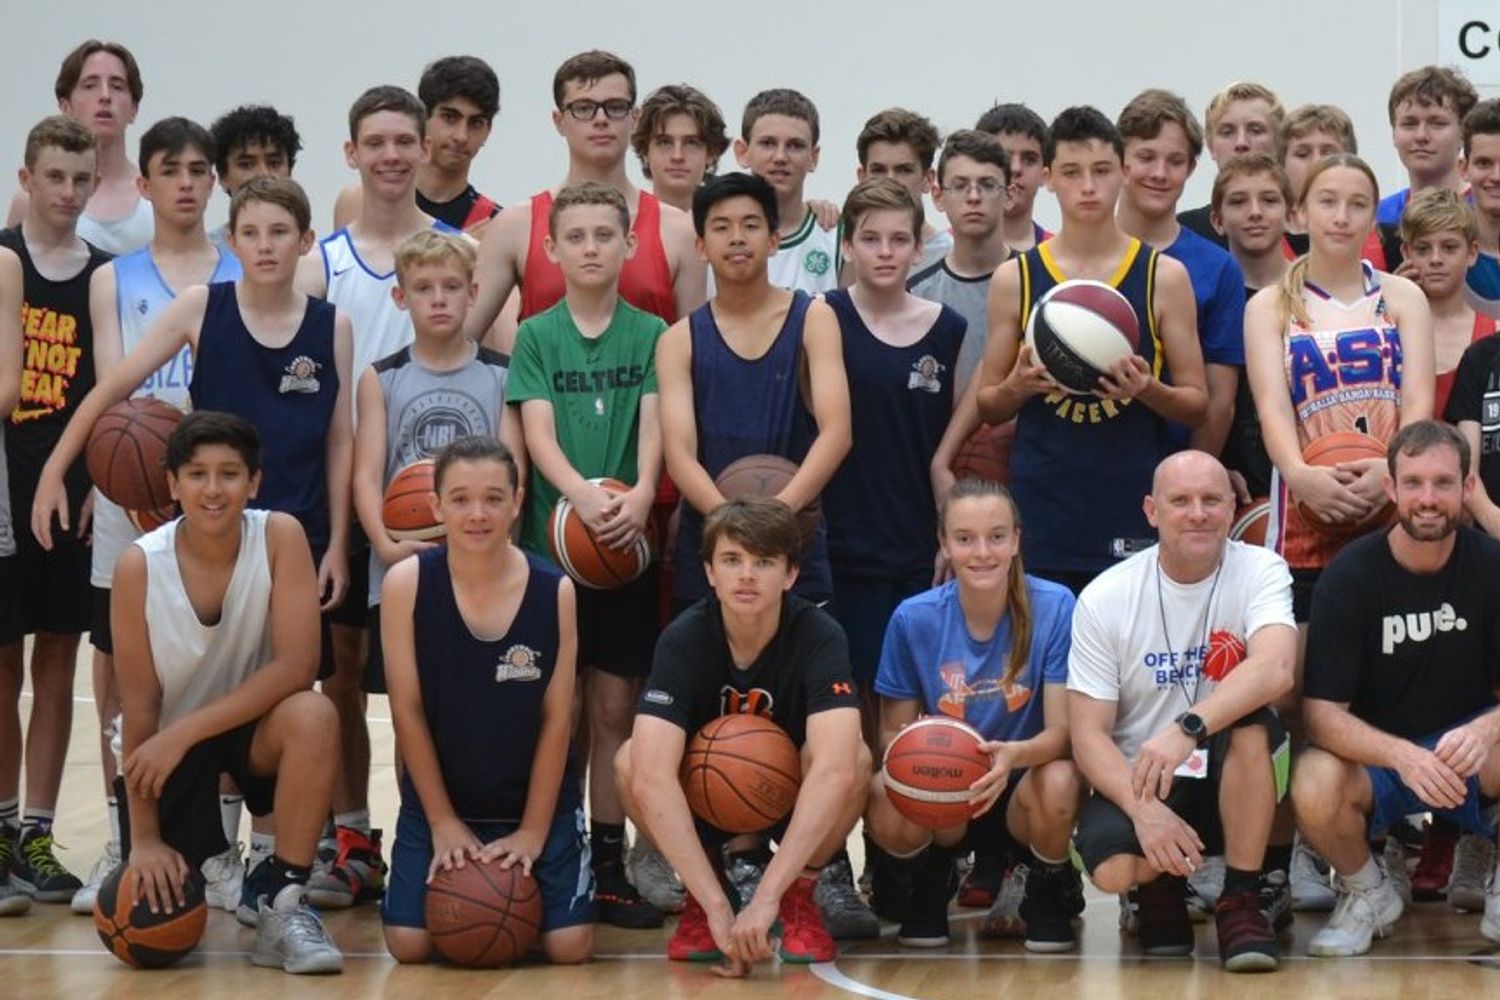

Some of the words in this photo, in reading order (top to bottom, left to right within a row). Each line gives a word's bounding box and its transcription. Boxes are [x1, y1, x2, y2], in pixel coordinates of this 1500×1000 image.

[22, 304, 77, 344] EAR
[26, 340, 81, 378] NOT
[21, 369, 69, 410] EAL
[553, 364, 646, 393] CELTICS
[1487, 403, 1500, 418] 19
[1143, 652, 1178, 668] OFF
